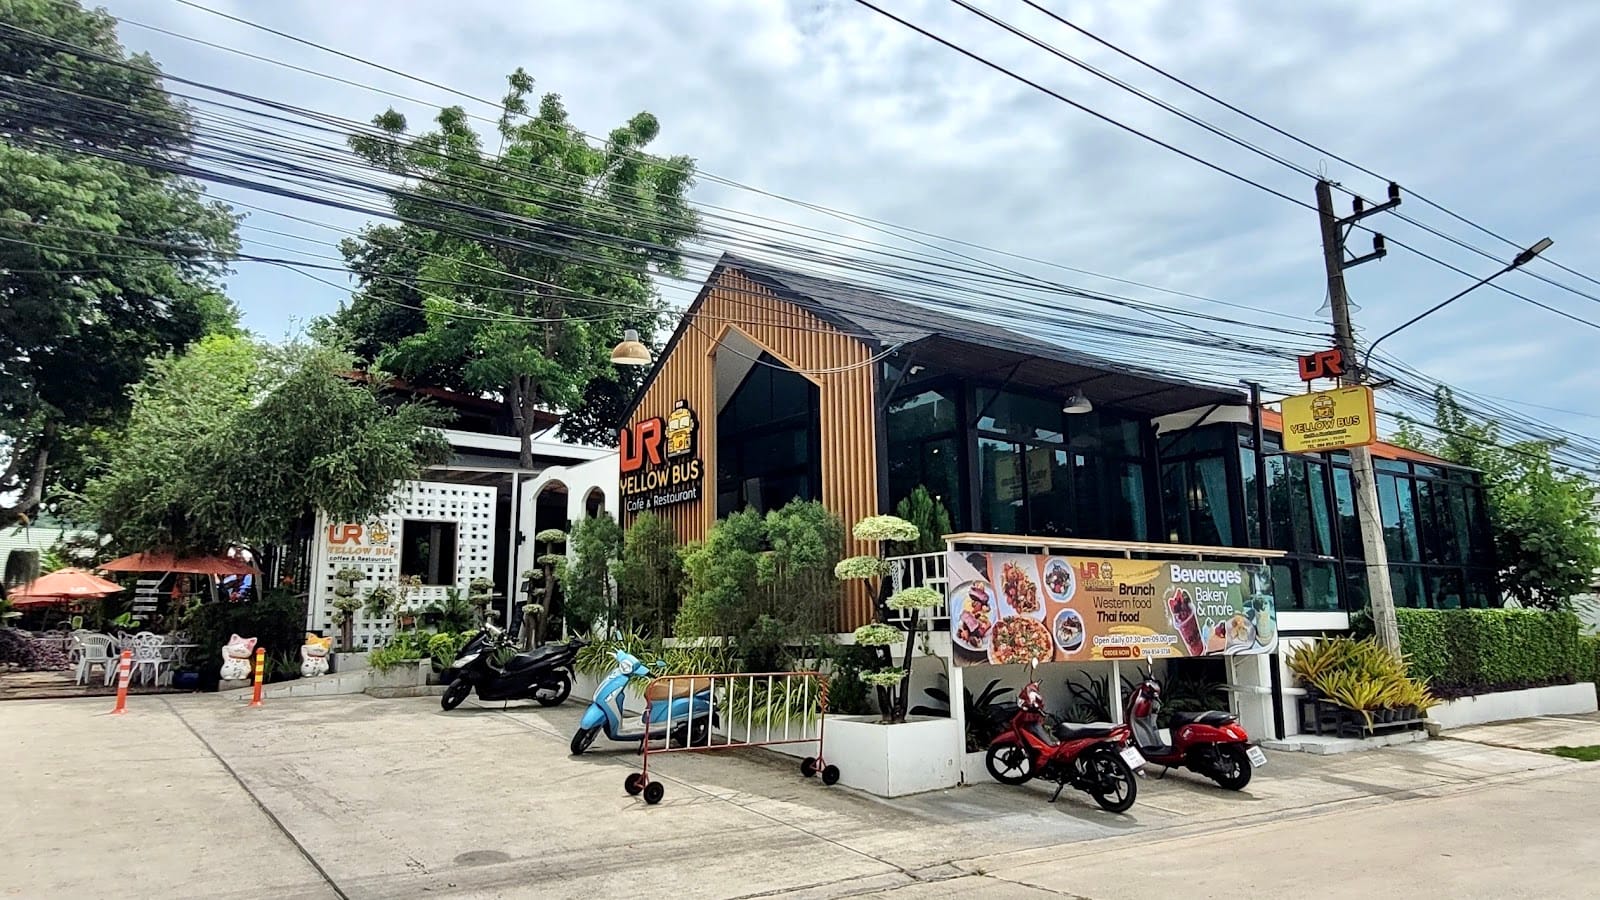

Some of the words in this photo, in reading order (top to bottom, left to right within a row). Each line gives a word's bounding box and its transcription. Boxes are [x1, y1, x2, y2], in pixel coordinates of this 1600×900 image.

[1290, 419, 1335, 434] YELLOW
[1337, 415, 1361, 427] BUS
[620, 467, 670, 496] YELLOW
[672, 459, 699, 485] BUS
[646, 499, 651, 508] &
[653, 487, 697, 507] Restaurant
[328, 546, 372, 555] YELLOW
[1170, 564, 1242, 588] Beverages
[1119, 583, 1155, 596] Brunch
[1195, 587, 1228, 605] Bakery
[1093, 597, 1131, 609] Western
[1132, 597, 1152, 609] food
[1197, 602, 1206, 616] &
[1207, 605, 1234, 616] more
[1097, 611, 1117, 623] Thai
[1119, 611, 1140, 622] food
[1094, 636, 1110, 645] Open
[1111, 636, 1125, 645] daily
